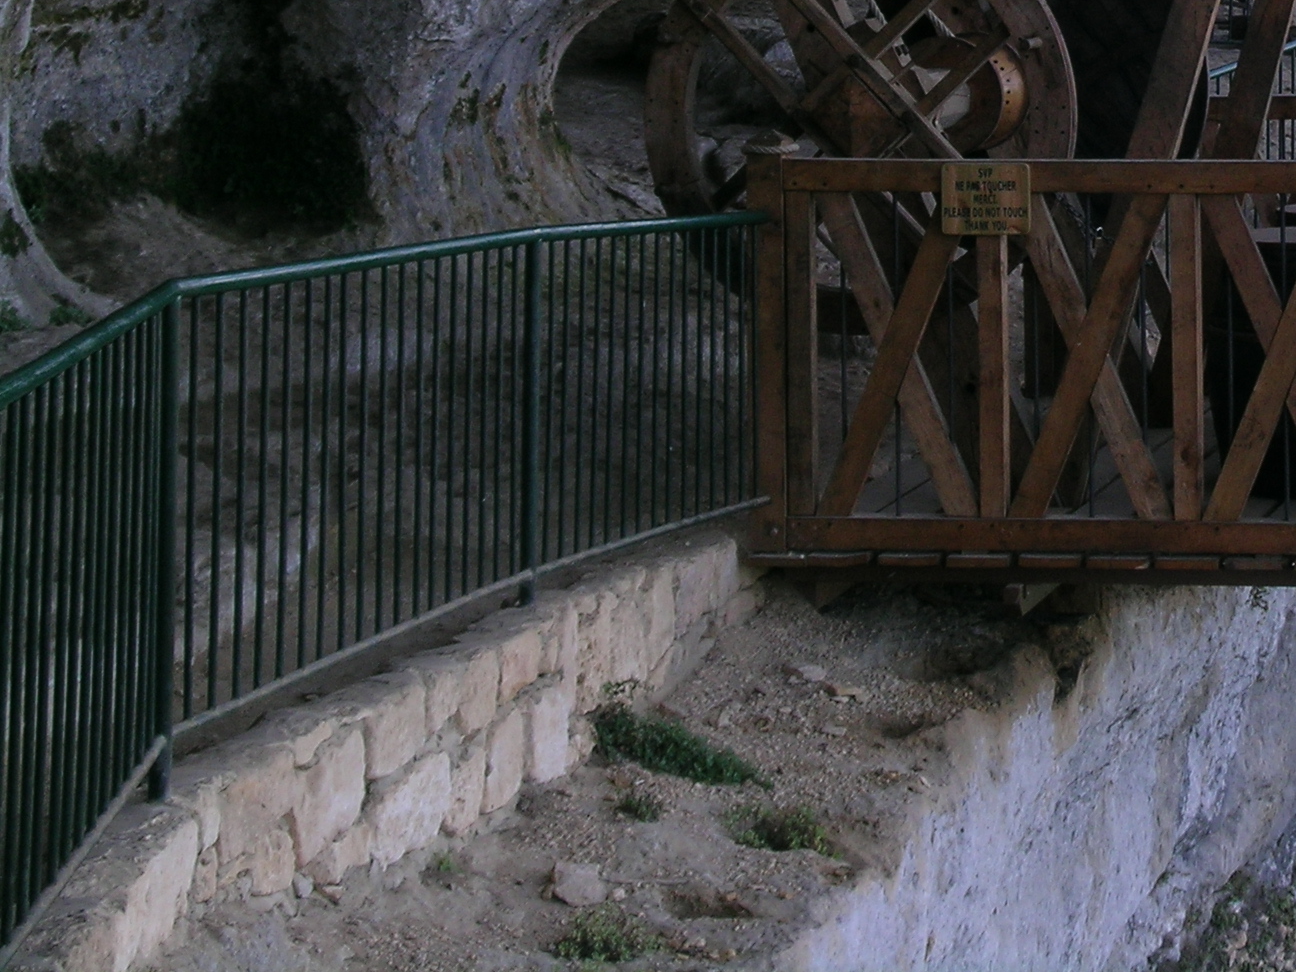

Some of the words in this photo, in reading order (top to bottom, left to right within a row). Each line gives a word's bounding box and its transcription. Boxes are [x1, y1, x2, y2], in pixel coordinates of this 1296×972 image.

[978, 168, 993, 178] SVP
[955, 181, 964, 191] NE
[943, 207, 971, 218] PLEASE
[973, 207, 983, 218] DO
[985, 207, 1000, 218] NOT
[1003, 207, 1028, 218] TOUCH
[964, 220, 989, 231] THANK
